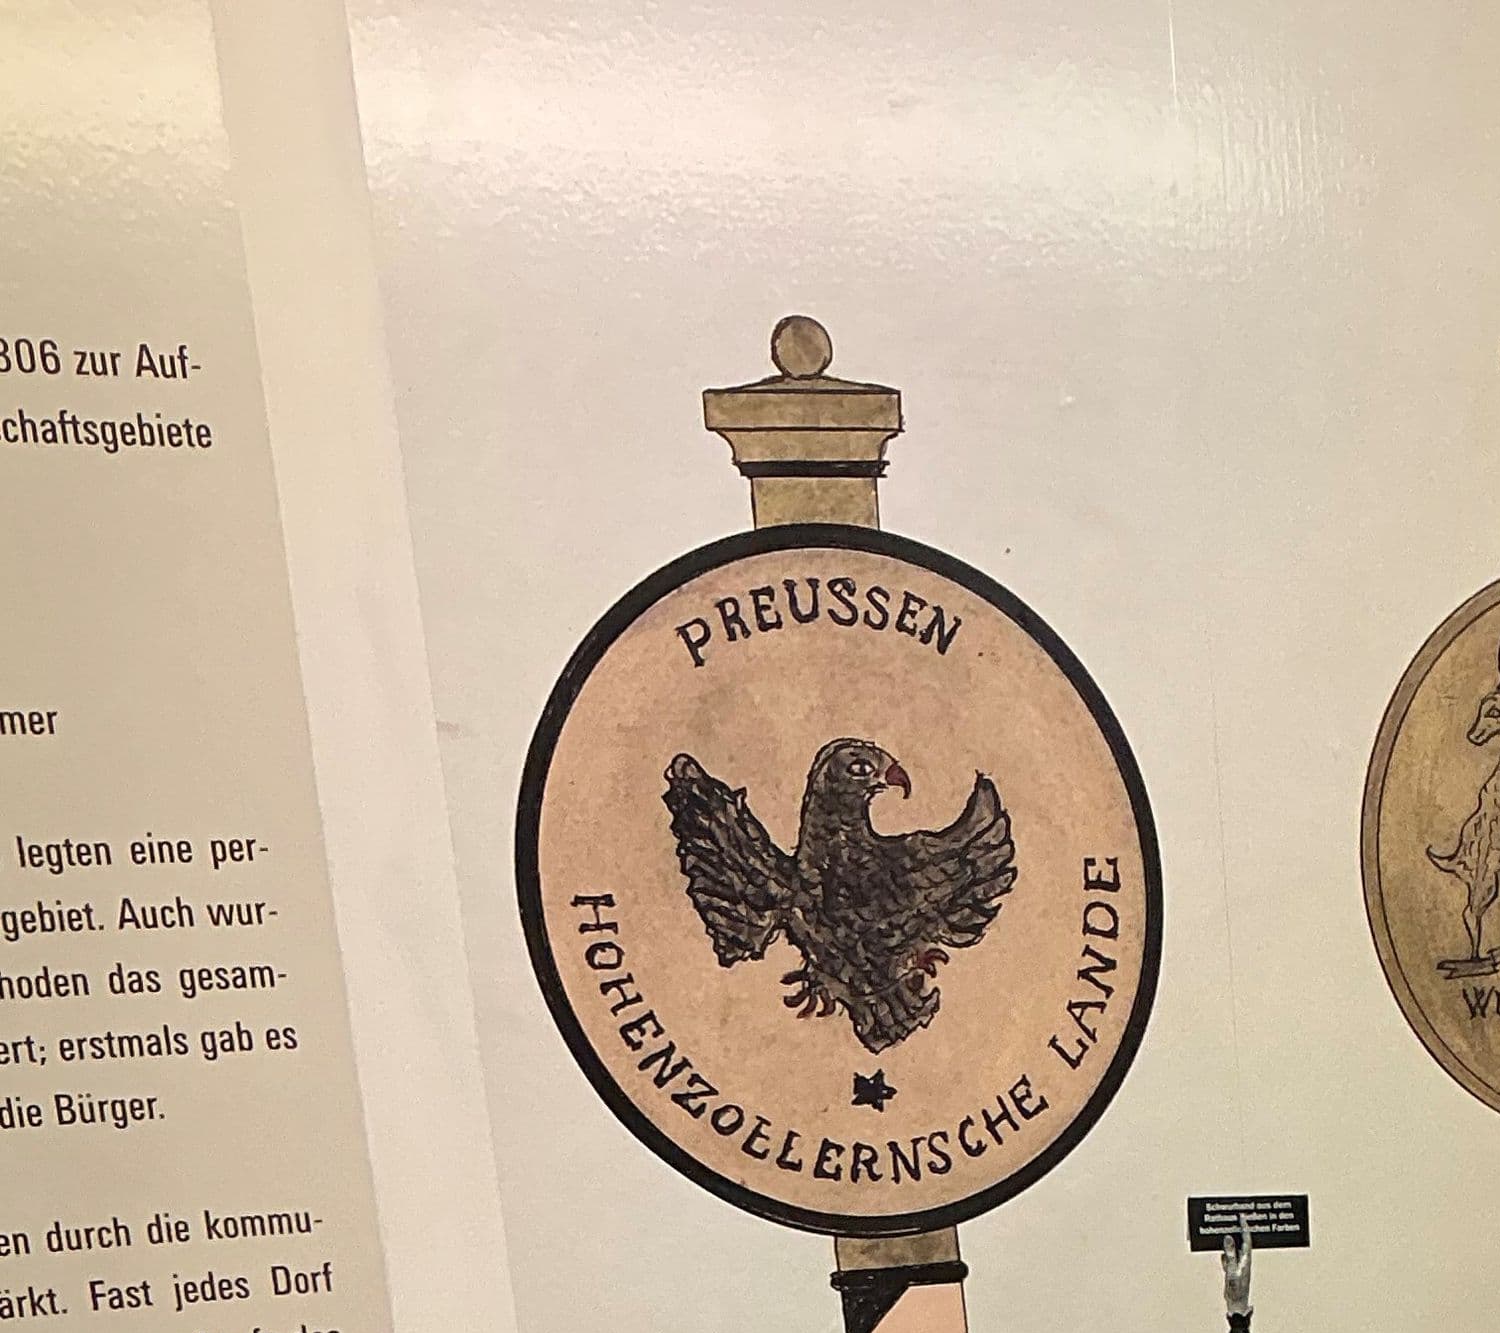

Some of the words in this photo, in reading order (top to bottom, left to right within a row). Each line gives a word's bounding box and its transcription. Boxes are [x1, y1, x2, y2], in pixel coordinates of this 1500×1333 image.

[74, 351, 121, 376] zur
[136, 344, 201, 379] Auf-
[0, 409, 212, 454] chaftsgebiete
[675, 576, 963, 667] PREUSSEN
[16, 836, 111, 875] legten
[131, 832, 192, 864] eine
[211, 839, 268, 870] per-
[1, 900, 104, 942] gebiet.
[119, 896, 194, 929] Auch
[206, 902, 278, 926] wur-
[109, 963, 161, 994] das
[180, 966, 286, 999] gesam-
[1047, 856, 1121, 1071] LANDE
[59, 1024, 188, 1061] erstmals
[201, 1021, 253, 1061] gab
[266, 1027, 297, 1050] es
[0, 1097, 42, 1129] die
[54, 1093, 165, 1129] Bürger.
[47, 1217, 131, 1252] durch
[147, 1213, 190, 1244] die
[204, 1210, 322, 1240] kommu-
[89, 1280, 153, 1311] Fast
[173, 1271, 249, 1312] jedes
[271, 1262, 332, 1295] Dorf
